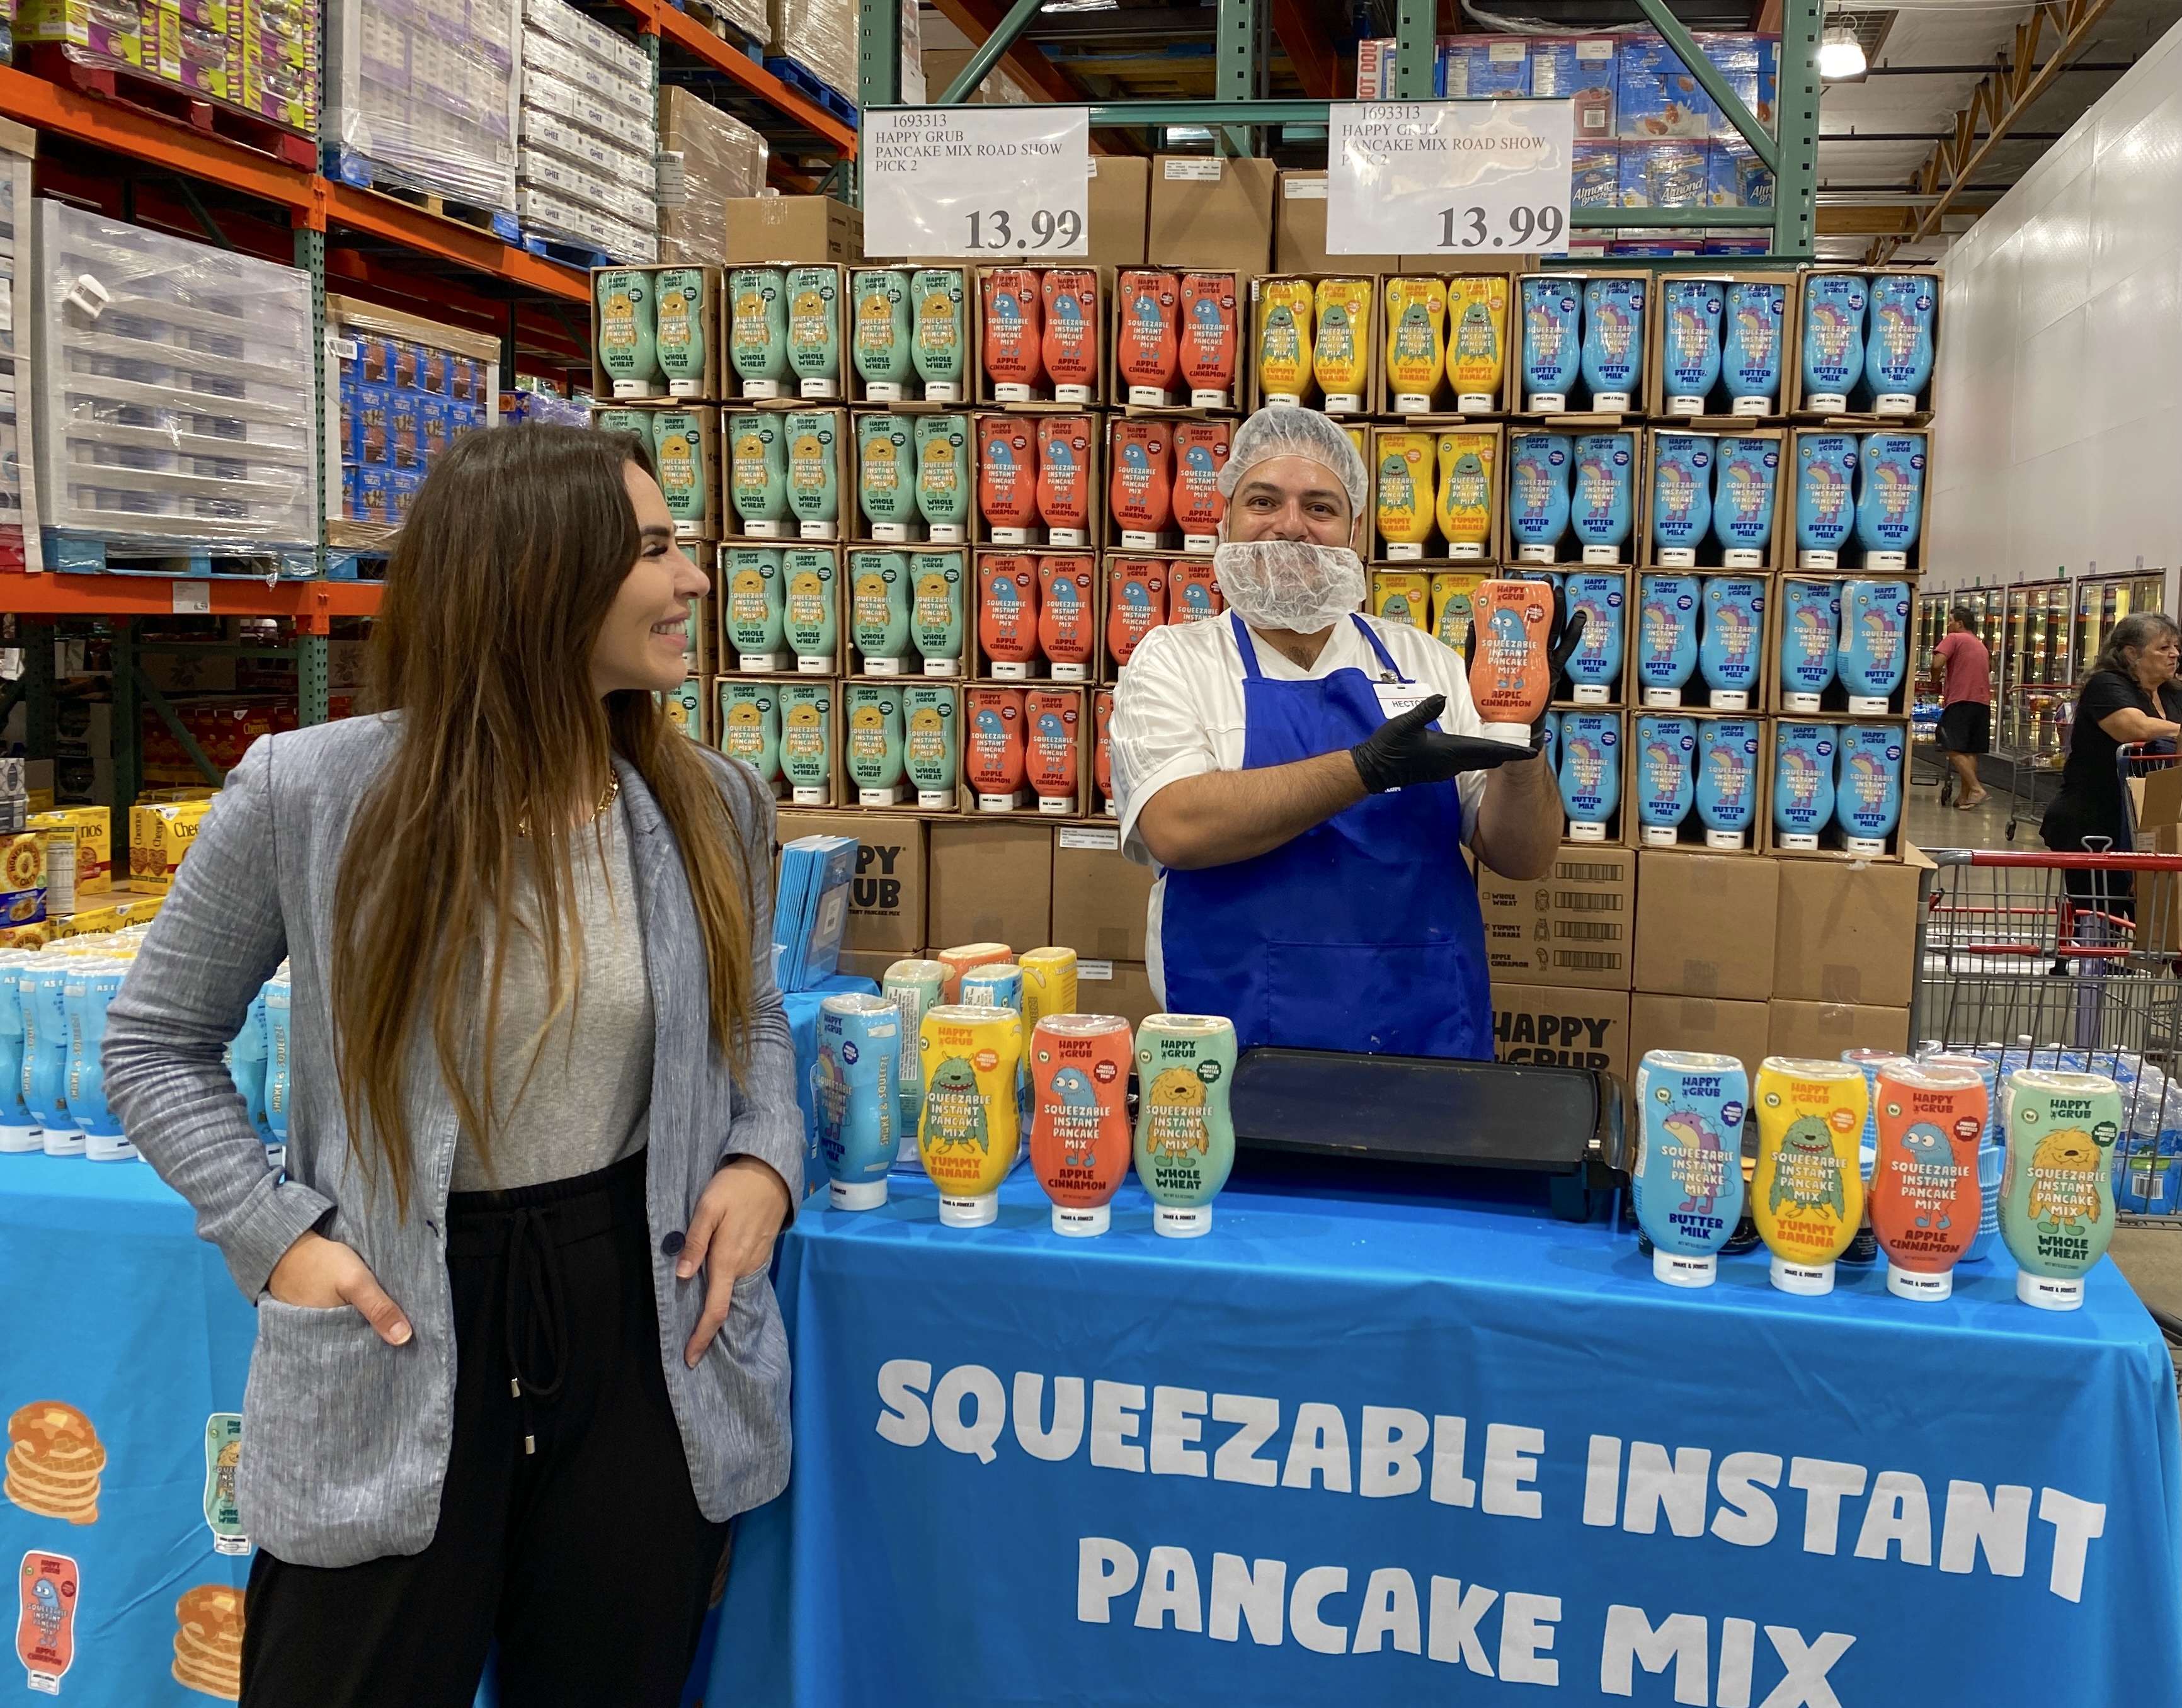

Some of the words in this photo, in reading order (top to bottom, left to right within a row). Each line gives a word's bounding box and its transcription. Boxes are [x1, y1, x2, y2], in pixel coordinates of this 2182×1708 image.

[1361, 41, 1378, 72] DOU
[1362, 106, 1420, 120] 1693313
[893, 114, 947, 127] 1693313
[544, 128, 558, 141] GHEE
[1343, 125, 1392, 136] HAPPY
[876, 132, 921, 143] HAPPY
[926, 131, 963, 142] GRUB
[1419, 139, 1447, 151] MIX
[1453, 138, 1495, 150] ROAD
[1500, 137, 1545, 149] SHOW
[590, 149, 603, 161] GHEE
[876, 145, 940, 157] PANCAKE
[945, 145, 971, 156] MIX
[978, 145, 1016, 156] ROAD
[1021, 144, 1063, 155] SHOW
[876, 161, 907, 171] PICK
[911, 160, 917, 171] 2
[1342, 155, 1375, 166] PK
[1381, 154, 1388, 166] 2
[545, 168, 559, 179] GHEE
[1573, 178, 1617, 203] Almond
[1661, 178, 1703, 201] Almond
[1580, 191, 1611, 207] Breeze
[546, 208, 559, 220] GHEE
[965, 210, 1082, 249] 13.99
[1437, 206, 1563, 247] 13.99
[1482, 640, 1537, 649] SQUEEZABLE
[1488, 658, 1528, 666] PANCAKE
[1492, 691, 1521, 699] APPLE
[1481, 699, 1531, 707] CINNAMON
[849, 878, 901, 908] UB
[825, 1014, 842, 1027] HAPPY
[827, 1024, 842, 1035] GRUB
[939, 1027, 973, 1037] HAPPY
[1492, 1011, 1611, 1048] HAPPY
[945, 1037, 973, 1045] GRUB
[1059, 1040, 1092, 1049] HAPPY
[1161, 1040, 1196, 1049] HAPPY
[1065, 1050, 1092, 1058] GRUB
[1168, 1050, 1196, 1058] GRUB
[878, 1054, 889, 1098] SQUEEZE
[1682, 1078, 1720, 1087] HAPPY
[822, 1087, 845, 1102] INSTANT
[1689, 1088, 1720, 1098] GRUB
[1791, 1083, 1830, 1095] HAPPY
[1798, 1095, 1830, 1104] GRUB
[1914, 1093, 1954, 1104] HAPPY
[2050, 1100, 2092, 1109] HAPPY
[822, 1098, 845, 1114] PANCAKE
[932, 1105, 979, 1115] INSTANT
[1044, 1104, 1111, 1117] SQUEEZABLE
[1146, 1105, 1213, 1117] SQUEEZABLE
[1921, 1104, 1953, 1113] GRUB
[828, 1110, 839, 1123] MIX
[2058, 1110, 2091, 1119] GRUB
[931, 1115, 979, 1127] PANCAKE
[1054, 1117, 1099, 1127] INSTANT
[1155, 1117, 1202, 1127] INSTANT
[881, 1113, 890, 1146] SHAKE
[943, 1128, 966, 1137] MIX
[1053, 1128, 1099, 1139] PANCAKE
[1153, 1129, 1202, 1139] PANCAKE
[821, 1137, 845, 1154] BUTTER
[1065, 1139, 1087, 1149] MIX
[1165, 1139, 1189, 1149] MIX
[826, 1149, 839, 1163] MILK
[1661, 1146, 1734, 1161] SQUEEZABLE
[930, 1156, 981, 1168] YUMMY
[1673, 1159, 1723, 1173] INSTANT
[1771, 1152, 1848, 1168] SQUEEZABLE
[931, 1167, 980, 1179] BANANA
[1059, 1169, 1094, 1180] APPLE
[1156, 1168, 1200, 1180] WHOLE
[1782, 1166, 1834, 1180] INSTANT
[1892, 1161, 1970, 1176] SQUEEZABLE
[1672, 1171, 1725, 1185] PANCAKE
[2026, 1168, 2106, 1182] SQUEEZABLE
[1048, 1178, 1105, 1190] CINNAMON
[1156, 1178, 1201, 1190] WHEAT
[1781, 1177, 1834, 1192] PANCAKE
[1902, 1176, 1957, 1188] INSTANT
[2038, 1181, 2093, 1193] INSTANT
[1685, 1183, 1710, 1195] MIX
[1902, 1187, 1956, 1200] PANCAKE
[1794, 1191, 1820, 1202] MIX
[2036, 1193, 2094, 1206] PANCAKE
[1915, 1200, 1941, 1210] MIX
[2051, 1206, 2078, 1216] MIX
[1669, 1214, 1723, 1229] BUTTER
[1777, 1219, 1836, 1236] YUMMY
[1681, 1226, 1711, 1239] MILK
[1905, 1230, 1948, 1243] APPLE
[1778, 1231, 1834, 1248] BANANA
[2038, 1235, 2089, 1249] WHOLE
[1890, 1239, 1960, 1253] CINNAMON
[2038, 1246, 2089, 1260] WHEAT
[876, 1359, 1545, 1519] SQUEEZABLE
[1582, 1434, 2107, 1603] INSTANT
[1077, 1537, 1562, 1687] PANCAKE
[1600, 1604, 1857, 1708] MIX
